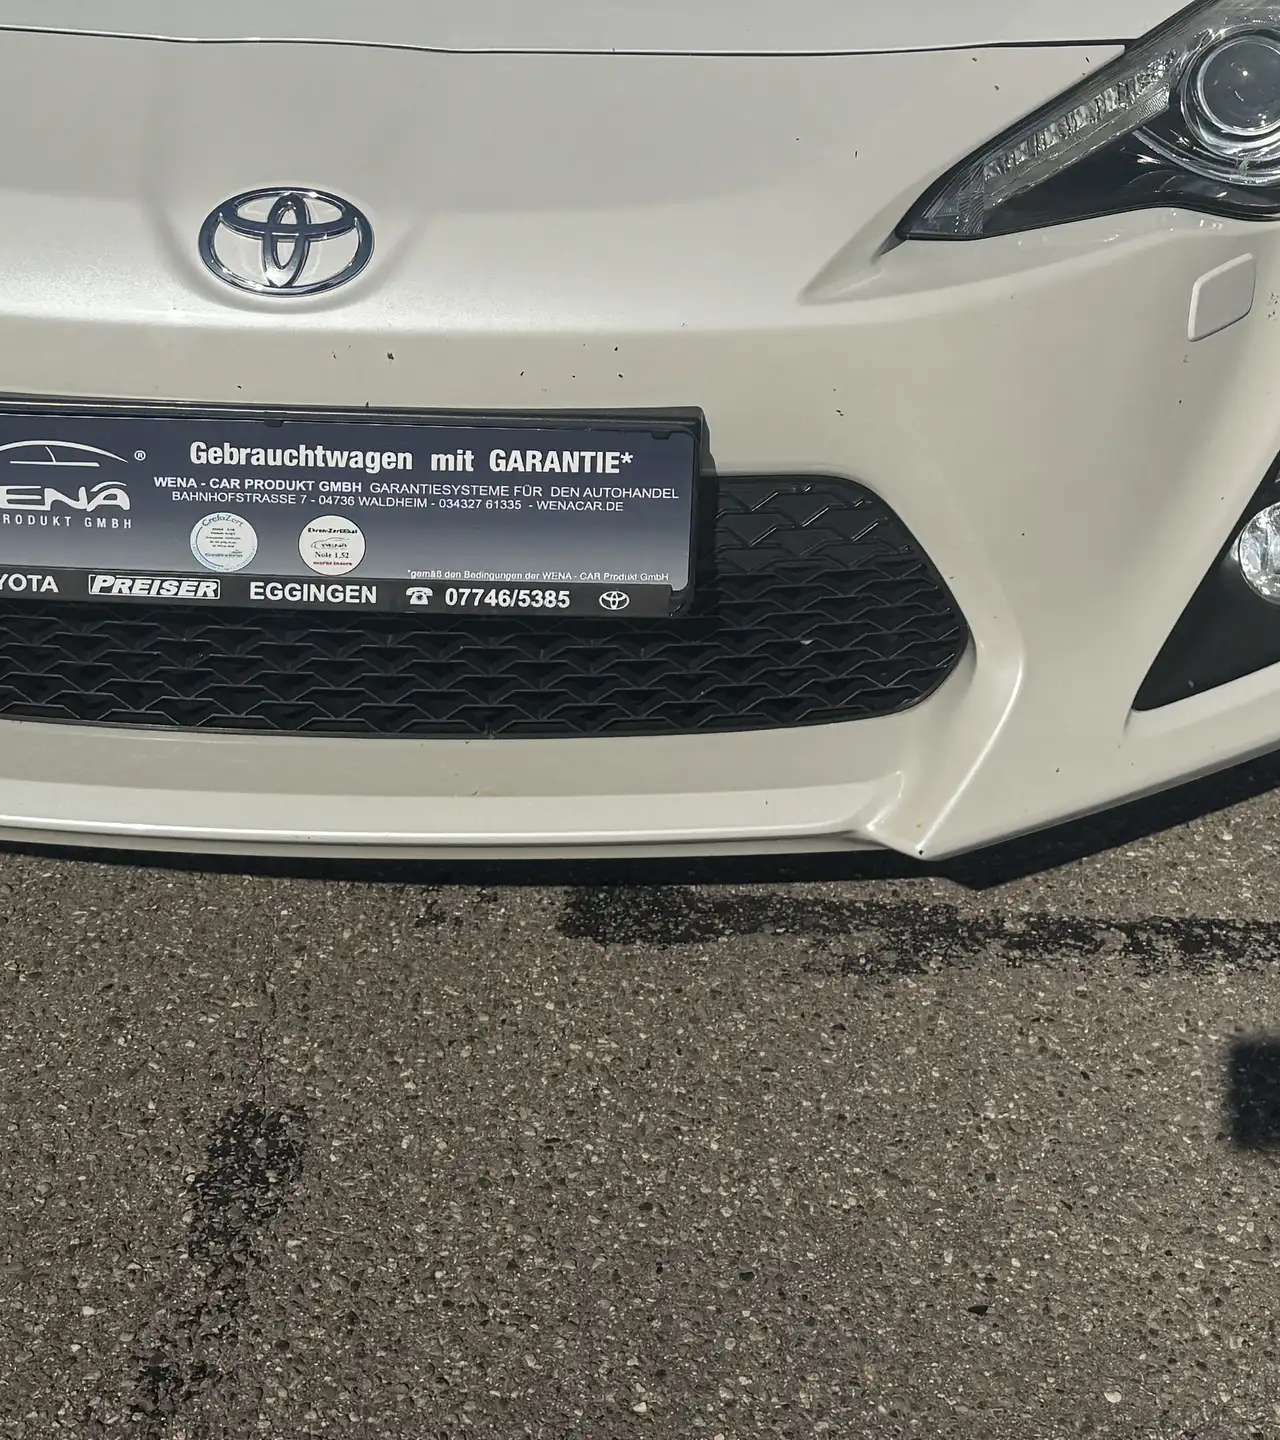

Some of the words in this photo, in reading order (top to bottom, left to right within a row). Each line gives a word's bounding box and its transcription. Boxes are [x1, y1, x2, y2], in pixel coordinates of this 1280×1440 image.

[189, 441, 413, 474] Gebrauchtwagen
[430, 448, 474, 472] mit
[154, 476, 197, 489] WENA
[209, 478, 241, 490] CAR
[244, 479, 315, 492] PRODUKT
[318, 481, 362, 493] GMBH
[369, 482, 509, 497] GARANTIESYSTEME
[513, 484, 542, 497] FÜR
[550, 486, 580, 498] DEN
[583, 486, 679, 499] AUTOHANDEL
[172, 491, 296, 504] BAHNHOFSTRASSE
[300, 494, 306, 504] 7
[318, 495, 355, 506] 04736
[358, 496, 428, 508] WALDHEIM
[438, 498, 482, 509] 034327
[485, 500, 522, 510] 61335
[536, 500, 624, 512] WENACAR.DE
[84, 517, 132, 529] GMBH
[542, 571, 572, 580] WENA
[579, 572, 601, 580] CAR
[603, 572, 637, 581] Produkt
[640, 572, 669, 581] GmbH
[90, 575, 219, 598] PREISER
[249, 581, 377, 603] EGGINGEN
[444, 587, 571, 609] 07746/5385
